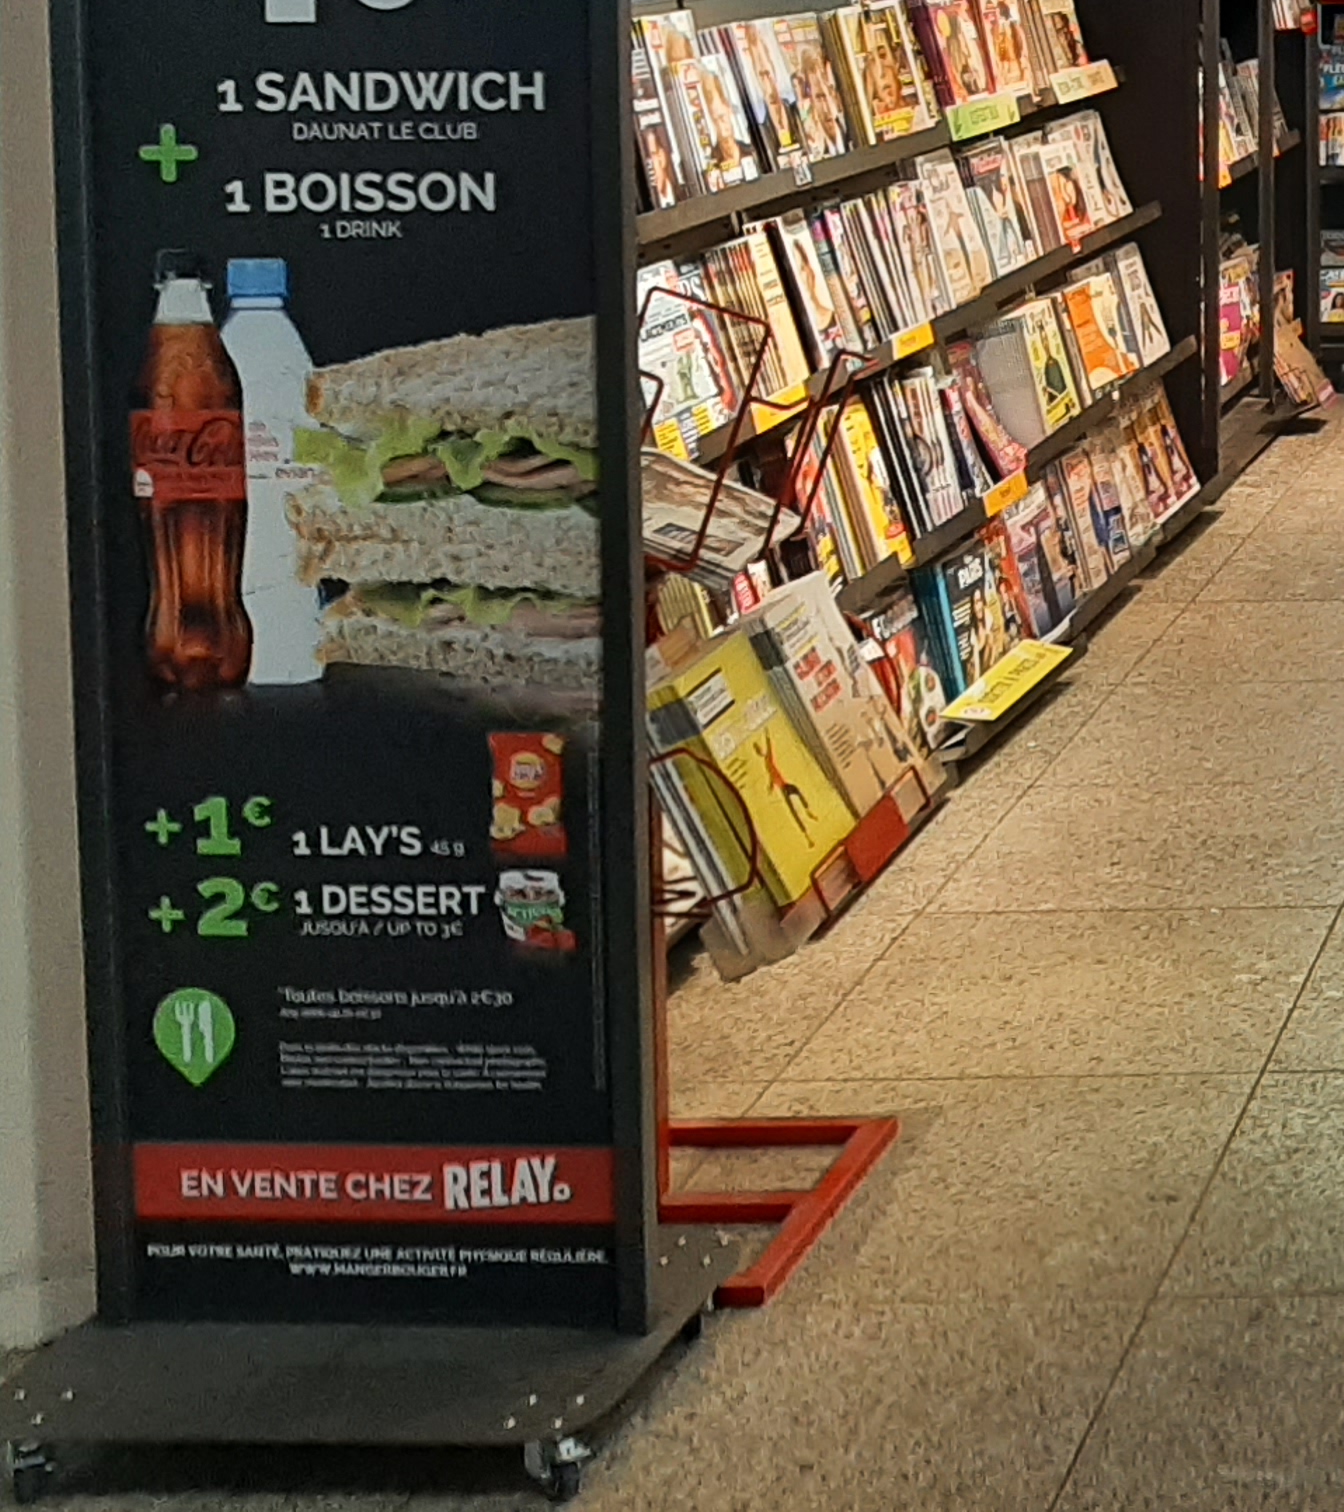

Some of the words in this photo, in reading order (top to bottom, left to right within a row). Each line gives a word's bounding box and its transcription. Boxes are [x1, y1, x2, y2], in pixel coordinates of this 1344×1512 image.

[217, 78, 243, 112] 1
[255, 70, 546, 113] SANDWICH
[292, 121, 384, 141] DAUNAT
[387, 121, 416, 140] LE
[418, 121, 479, 141] CLUB
[225, 180, 251, 213] 1
[264, 171, 498, 213] BOISSON
[334, 220, 403, 240] DRINK
[292, 831, 312, 856] 1
[319, 824, 423, 857] LAY'S
[294, 889, 313, 916] 1
[321, 884, 487, 916] DESSERT
[387, 920, 412, 937] UP
[414, 920, 437, 937] TO
[181, 1168, 225, 1199] EN
[231, 1170, 338, 1200] VENTE
[345, 1171, 433, 1201] CHEZ
